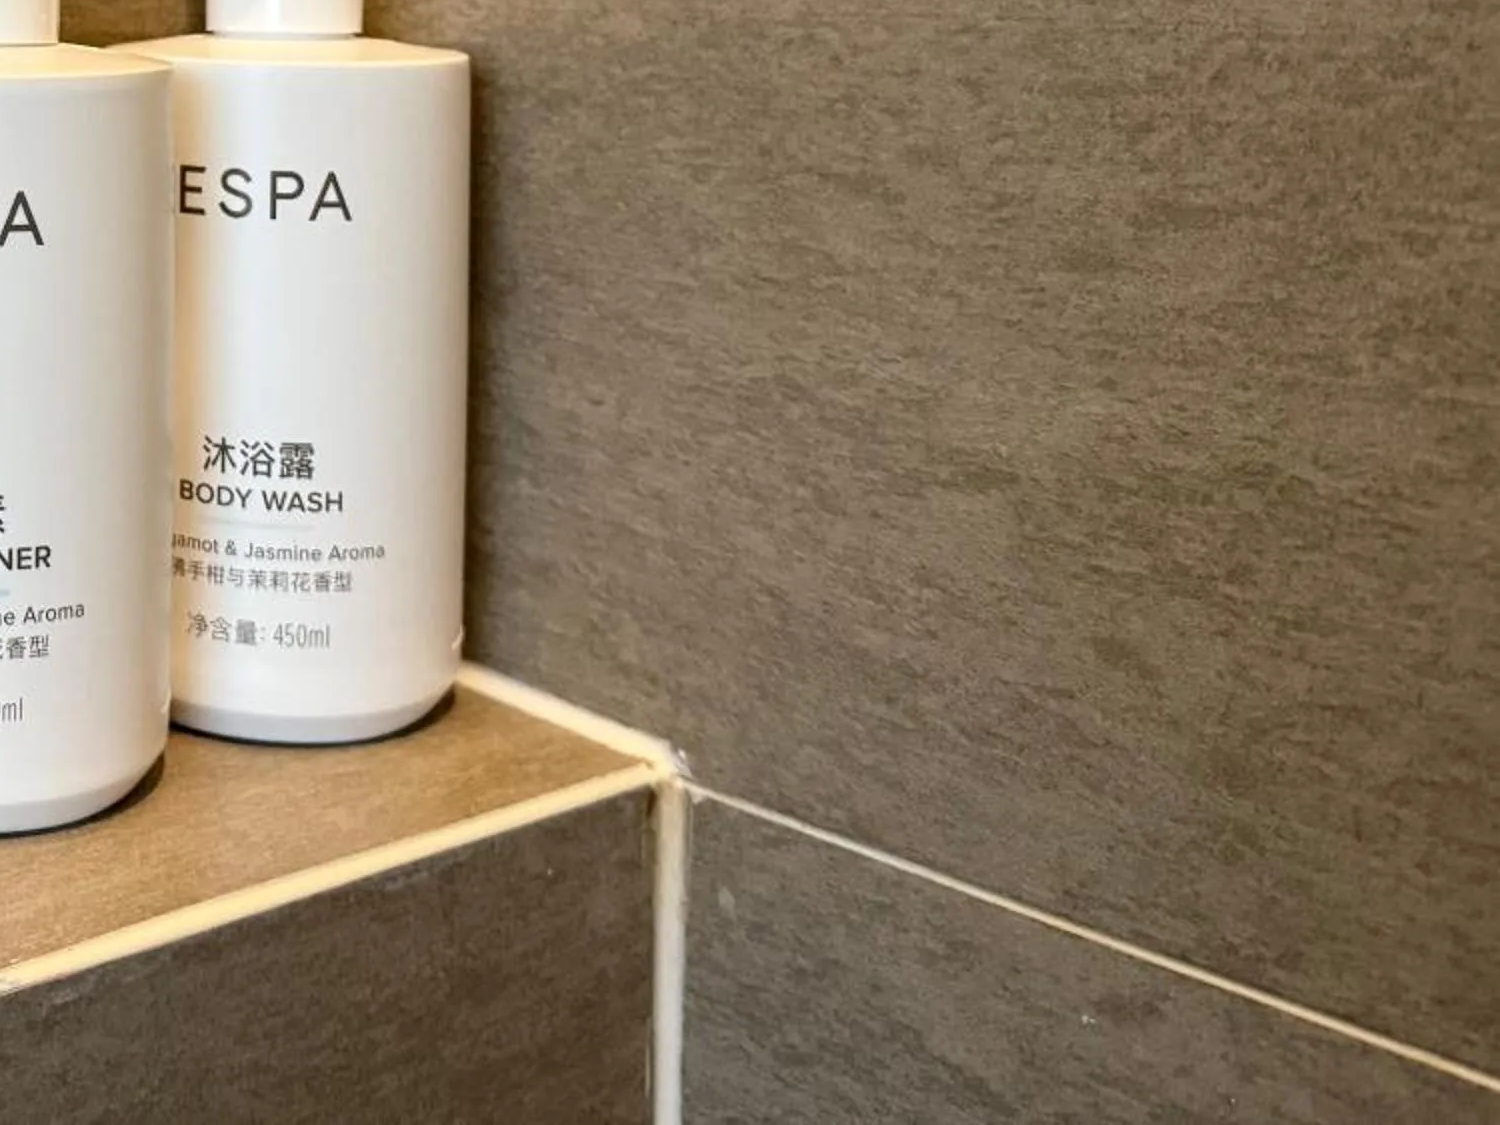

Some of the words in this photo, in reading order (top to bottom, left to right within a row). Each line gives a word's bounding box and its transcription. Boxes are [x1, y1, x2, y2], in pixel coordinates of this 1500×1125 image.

[176, 164, 353, 223] ESPA
[203, 436, 315, 480] 沐浴露
[179, 479, 252, 512] BODY
[262, 490, 344, 513] WASH
[224, 539, 237, 557] &
[243, 542, 323, 562] Jasmine
[327, 543, 386, 562] Aroma
[23, 601, 85, 623] Aroma
[272, 624, 331, 648] 450ml
